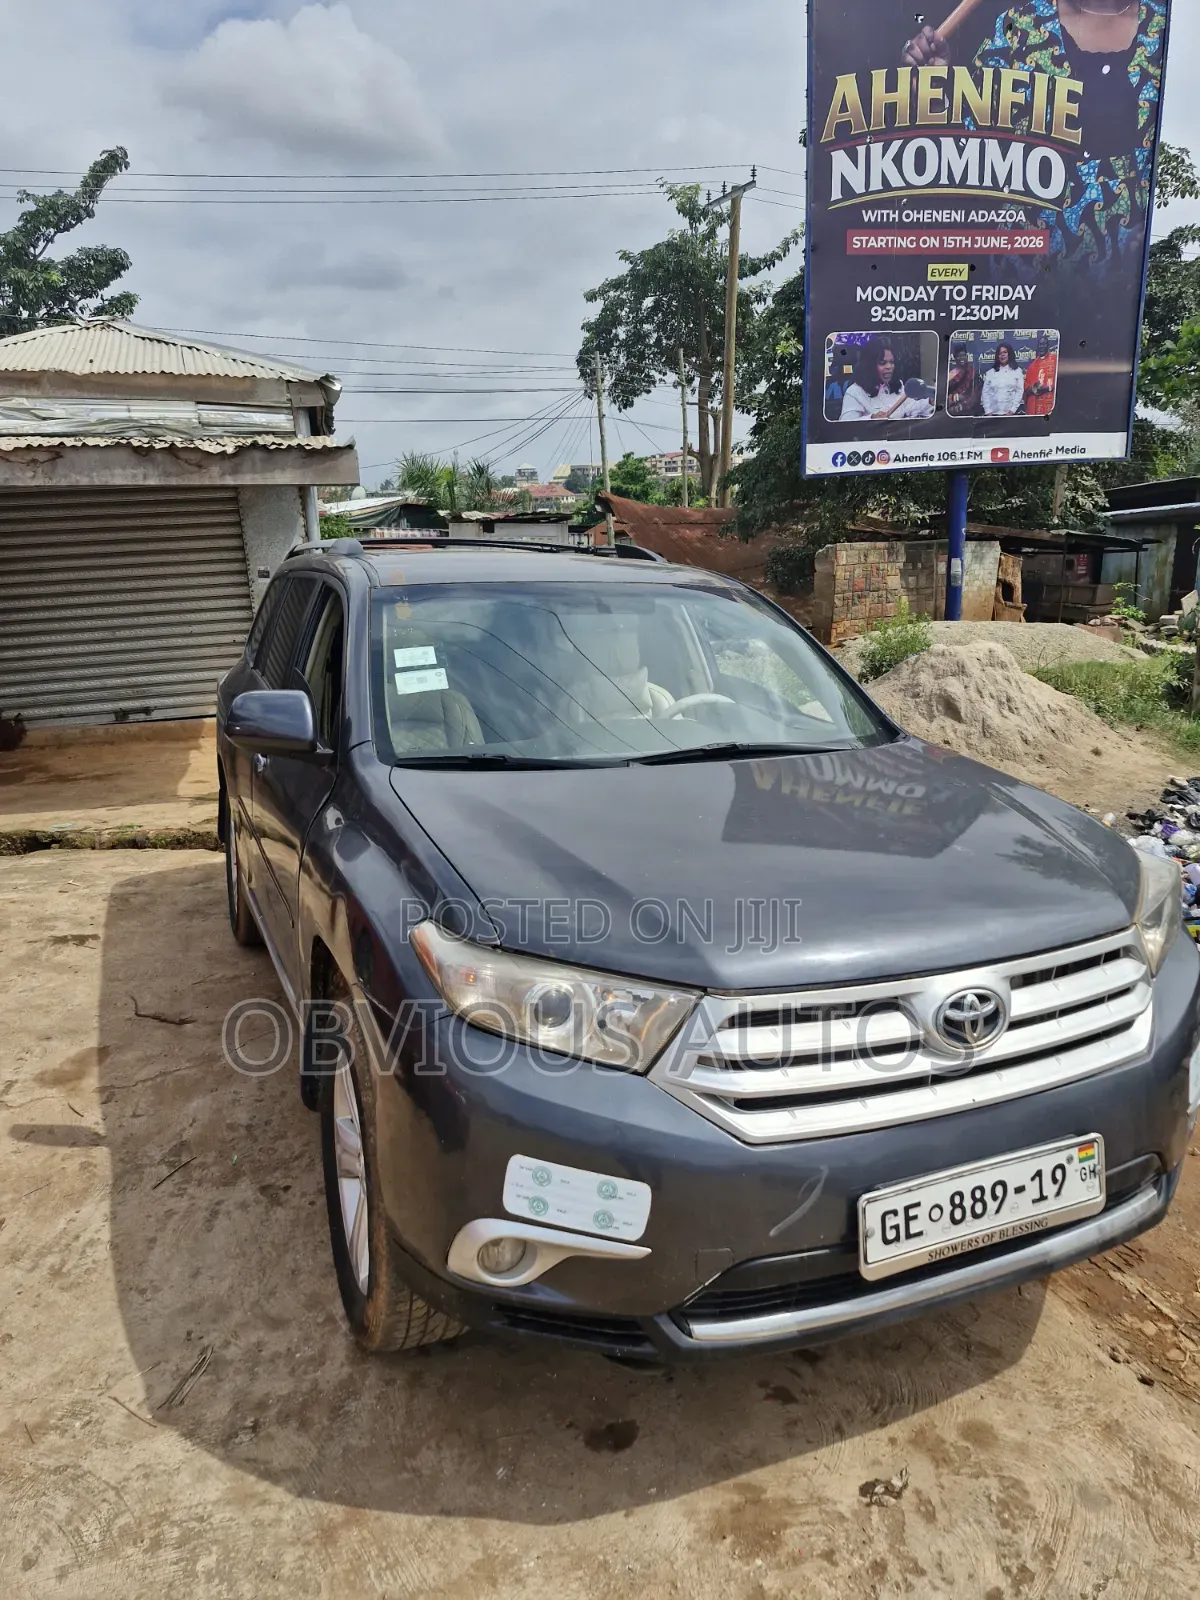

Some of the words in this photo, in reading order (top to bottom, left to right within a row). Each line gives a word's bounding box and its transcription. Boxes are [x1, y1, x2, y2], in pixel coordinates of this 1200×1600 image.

[820, 65, 1083, 144] AHENFIE
[830, 137, 1066, 201] NKOMMO
[862, 210, 899, 223] WITH
[901, 209, 966, 223] OHENENI
[967, 209, 1026, 223] ADAZOA
[852, 236, 917, 249] STARTING
[919, 236, 941, 249] ON
[943, 236, 970, 248] 15TH
[973, 236, 1011, 250] JUNE,
[1013, 235, 1044, 249] 2026
[929, 267, 965, 278] EVERY
[856, 285, 939, 303] MONDAY
[942, 286, 968, 301] TO
[971, 284, 1037, 301] FRIDAY
[870, 305, 935, 322] 9:30am
[950, 305, 1019, 322] 12:30PM
[893, 453, 935, 464] Ahenfie
[967, 451, 983, 461] FM
[1055, 445, 1087, 455] Media
[1079, 1164, 1098, 1183] GH
[880, 1201, 924, 1246] GE
[949, 1163, 1067, 1226] 889-19
[928, 1236, 980, 1262] SHOWERS
[981, 1230, 997, 1245] OF
[999, 1217, 1049, 1240] BLESSING
